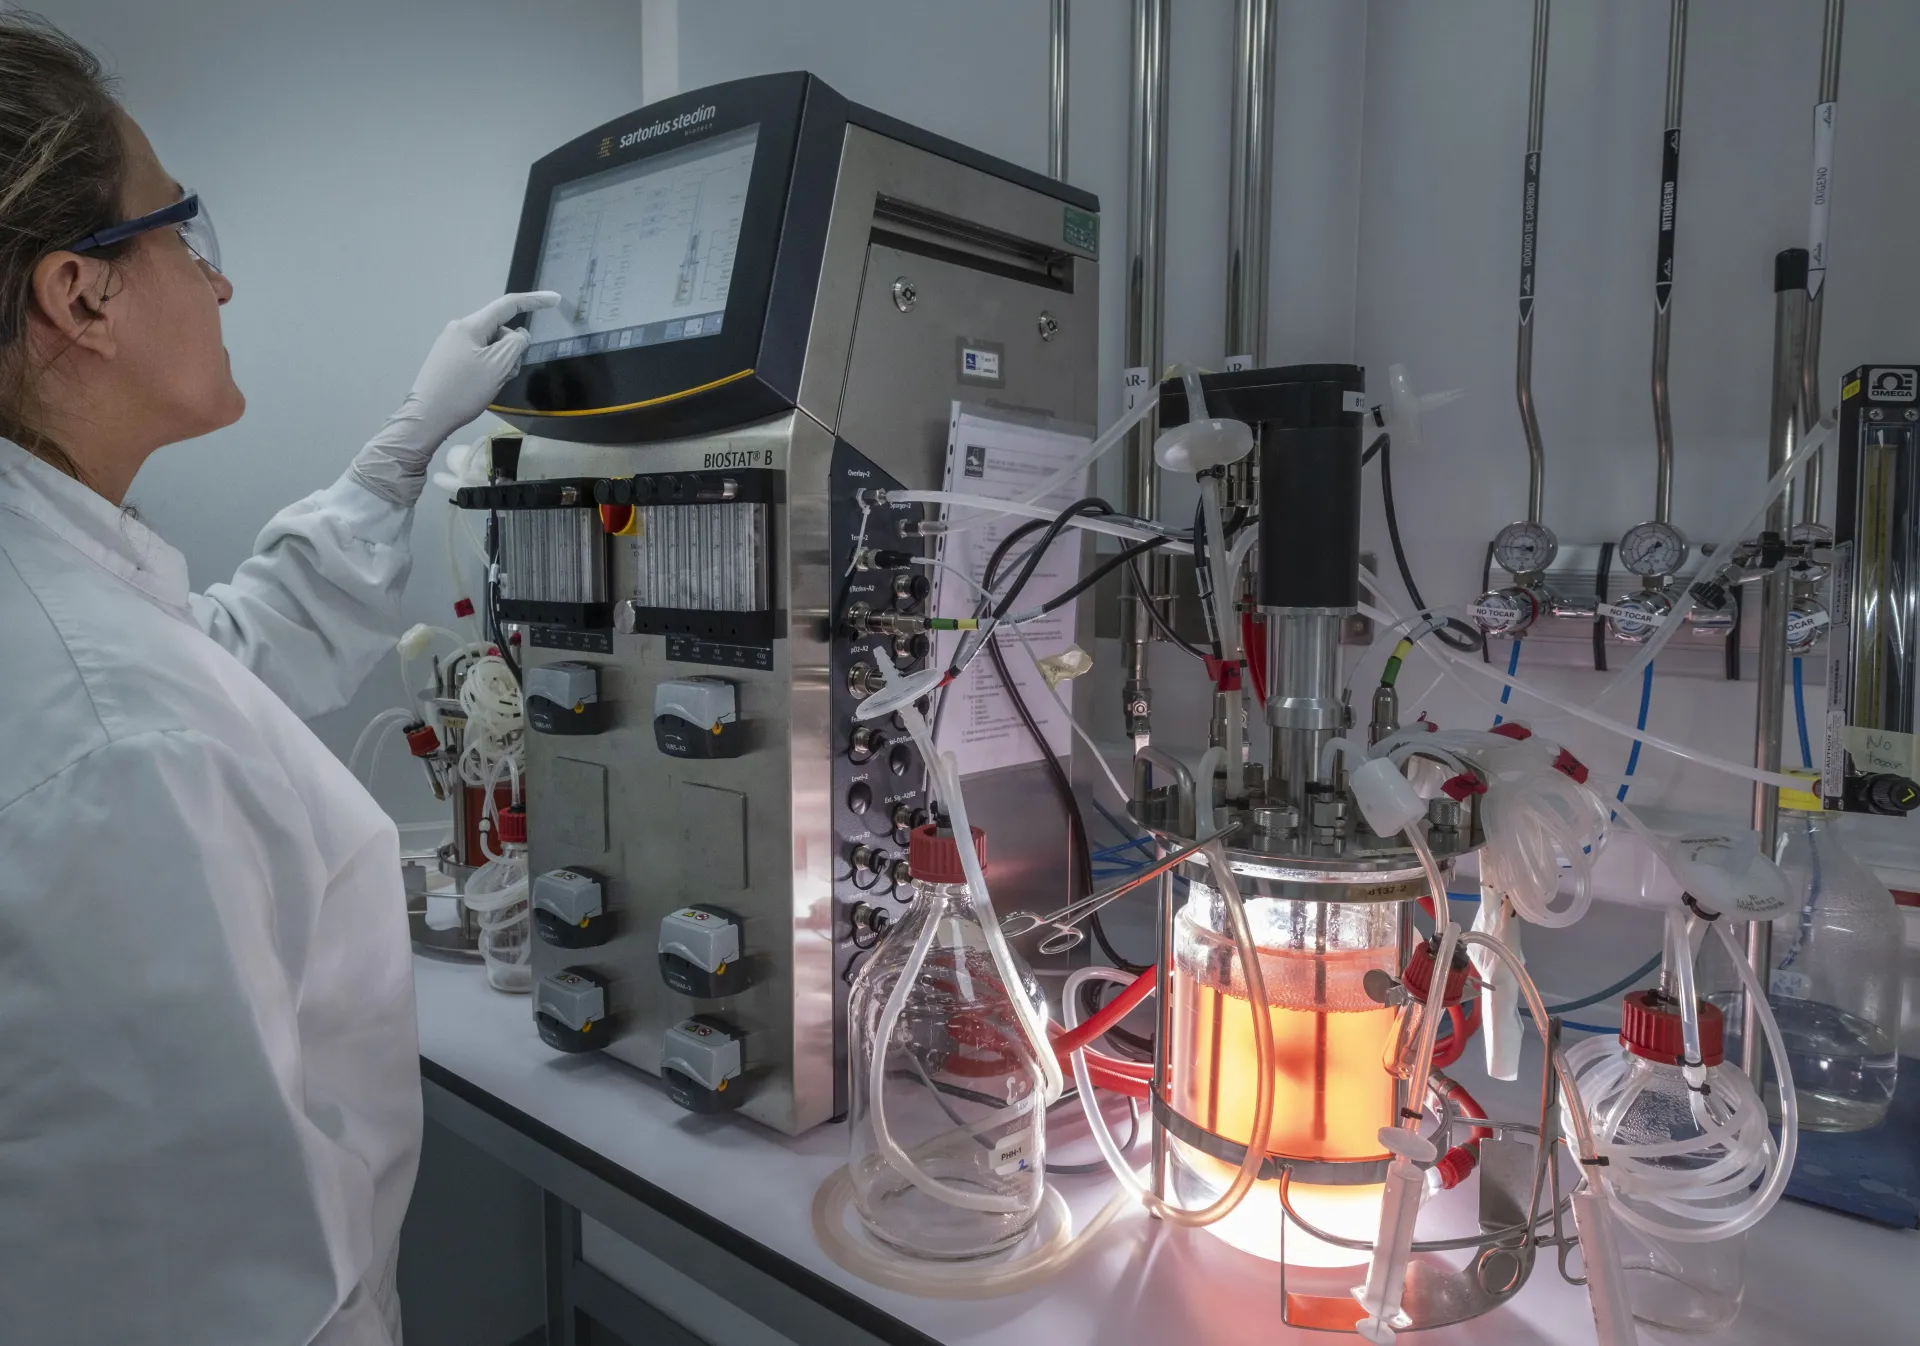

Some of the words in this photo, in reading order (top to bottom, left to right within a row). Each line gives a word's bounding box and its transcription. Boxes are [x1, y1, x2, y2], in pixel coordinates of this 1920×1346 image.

[620, 120, 671, 148] sartorius
[672, 104, 716, 131] stedim
[1525, 182, 1536, 221] CARBONO
[1661, 181, 1675, 232] NITRÓGENO
[1524, 221, 1534, 233] DE
[764, 449, 773, 466] B
[847, 469, 871, 478] Overlay-2
[1488, 609, 1515, 618] TOCAR
[1610, 608, 1623, 616] NO
[1624, 610, 1653, 622] TOCAR
[1787, 618, 1815, 632] OCAR
[1866, 735, 1892, 750] No
[851, 773, 869, 782] Level-2
[1001, 1147, 1022, 1160] PHH-1
